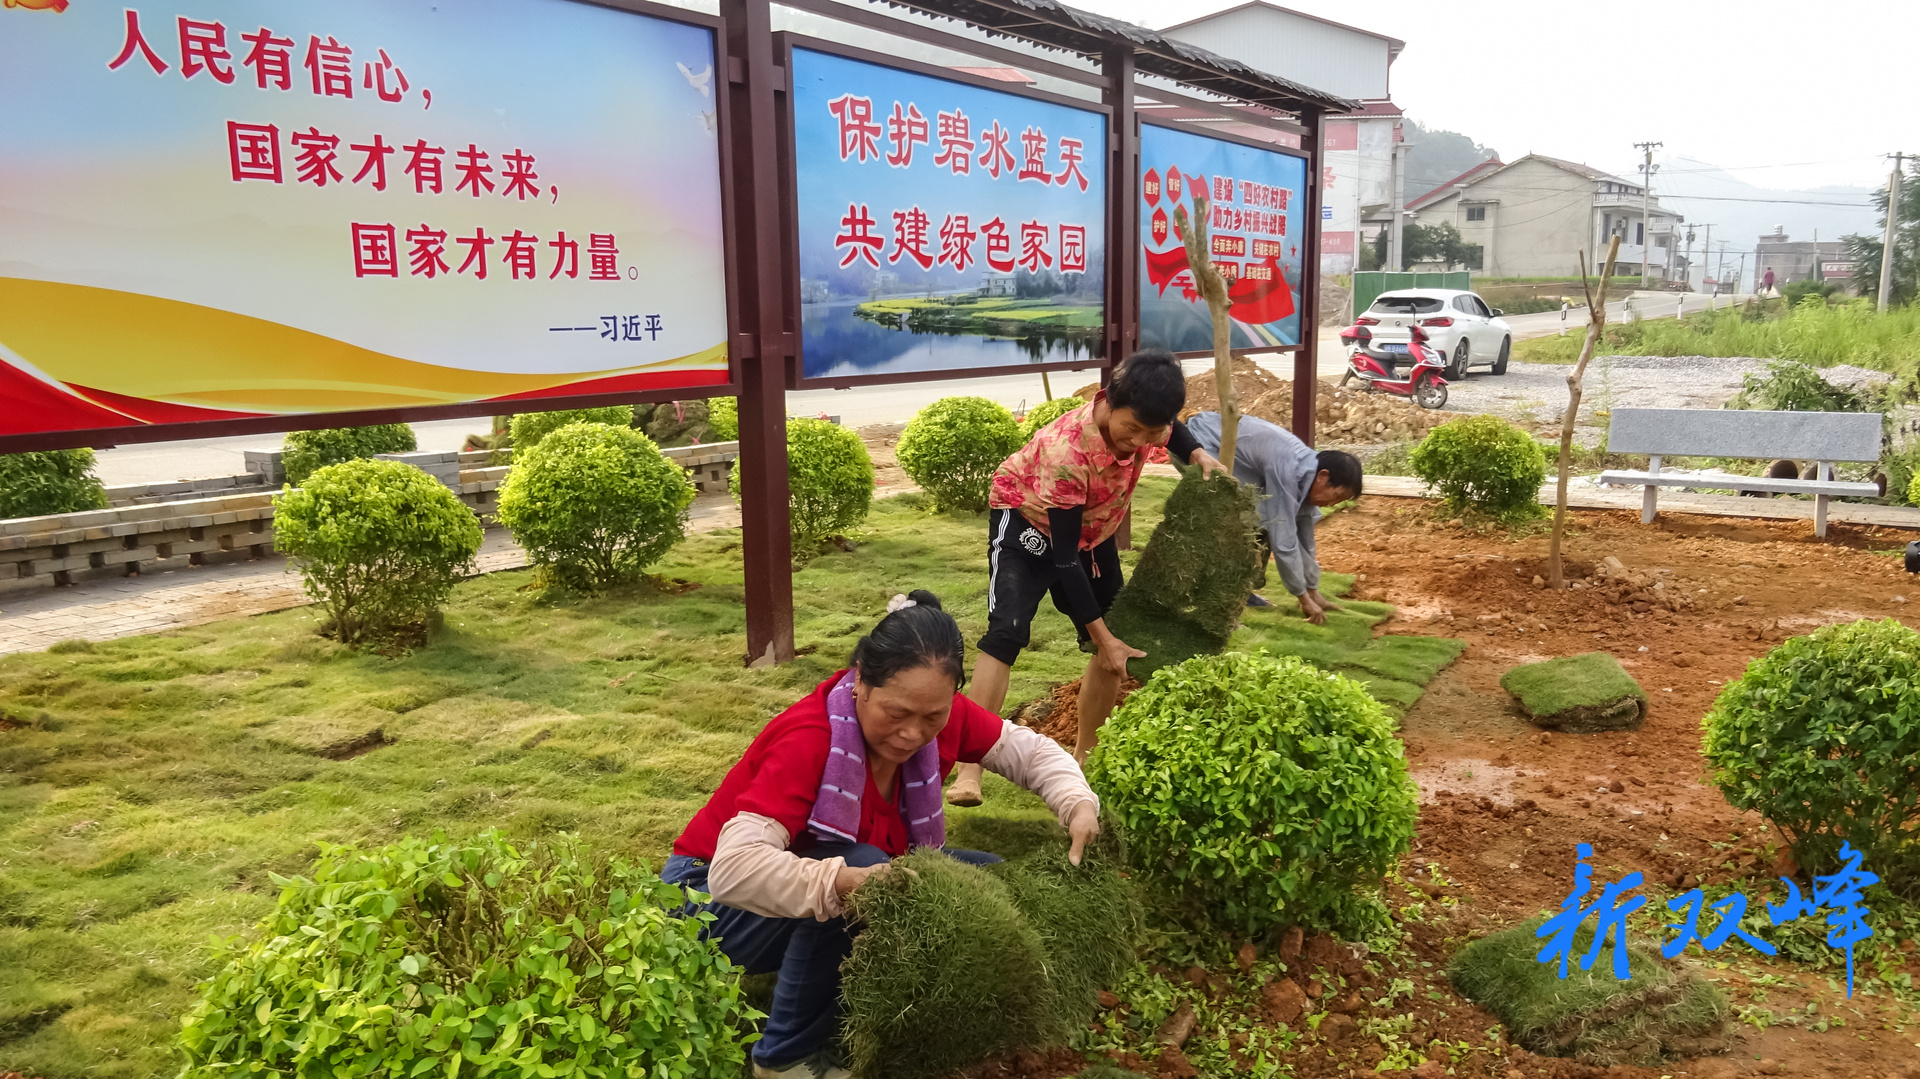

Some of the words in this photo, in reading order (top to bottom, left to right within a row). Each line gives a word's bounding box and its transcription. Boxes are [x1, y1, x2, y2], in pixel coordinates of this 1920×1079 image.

[108, 8, 433, 110] 人民有信心，
[828, 93, 1089, 192] 保护碧水蓝天
[227, 120, 560, 205] 国家才有未来，
[1146, 181, 1158, 195] 建好
[835, 202, 1087, 274] 共建绿色家园
[1154, 220, 1166, 233] 护好
[1213, 204, 1287, 238] 助力乡村振兴战略
[351, 222, 638, 282] 国家才有力量。
[1213, 238, 1244, 254] 全面奔小康
[1254, 242, 1279, 257] 关键在农村
[1246, 266, 1272, 280] 基础在交通
